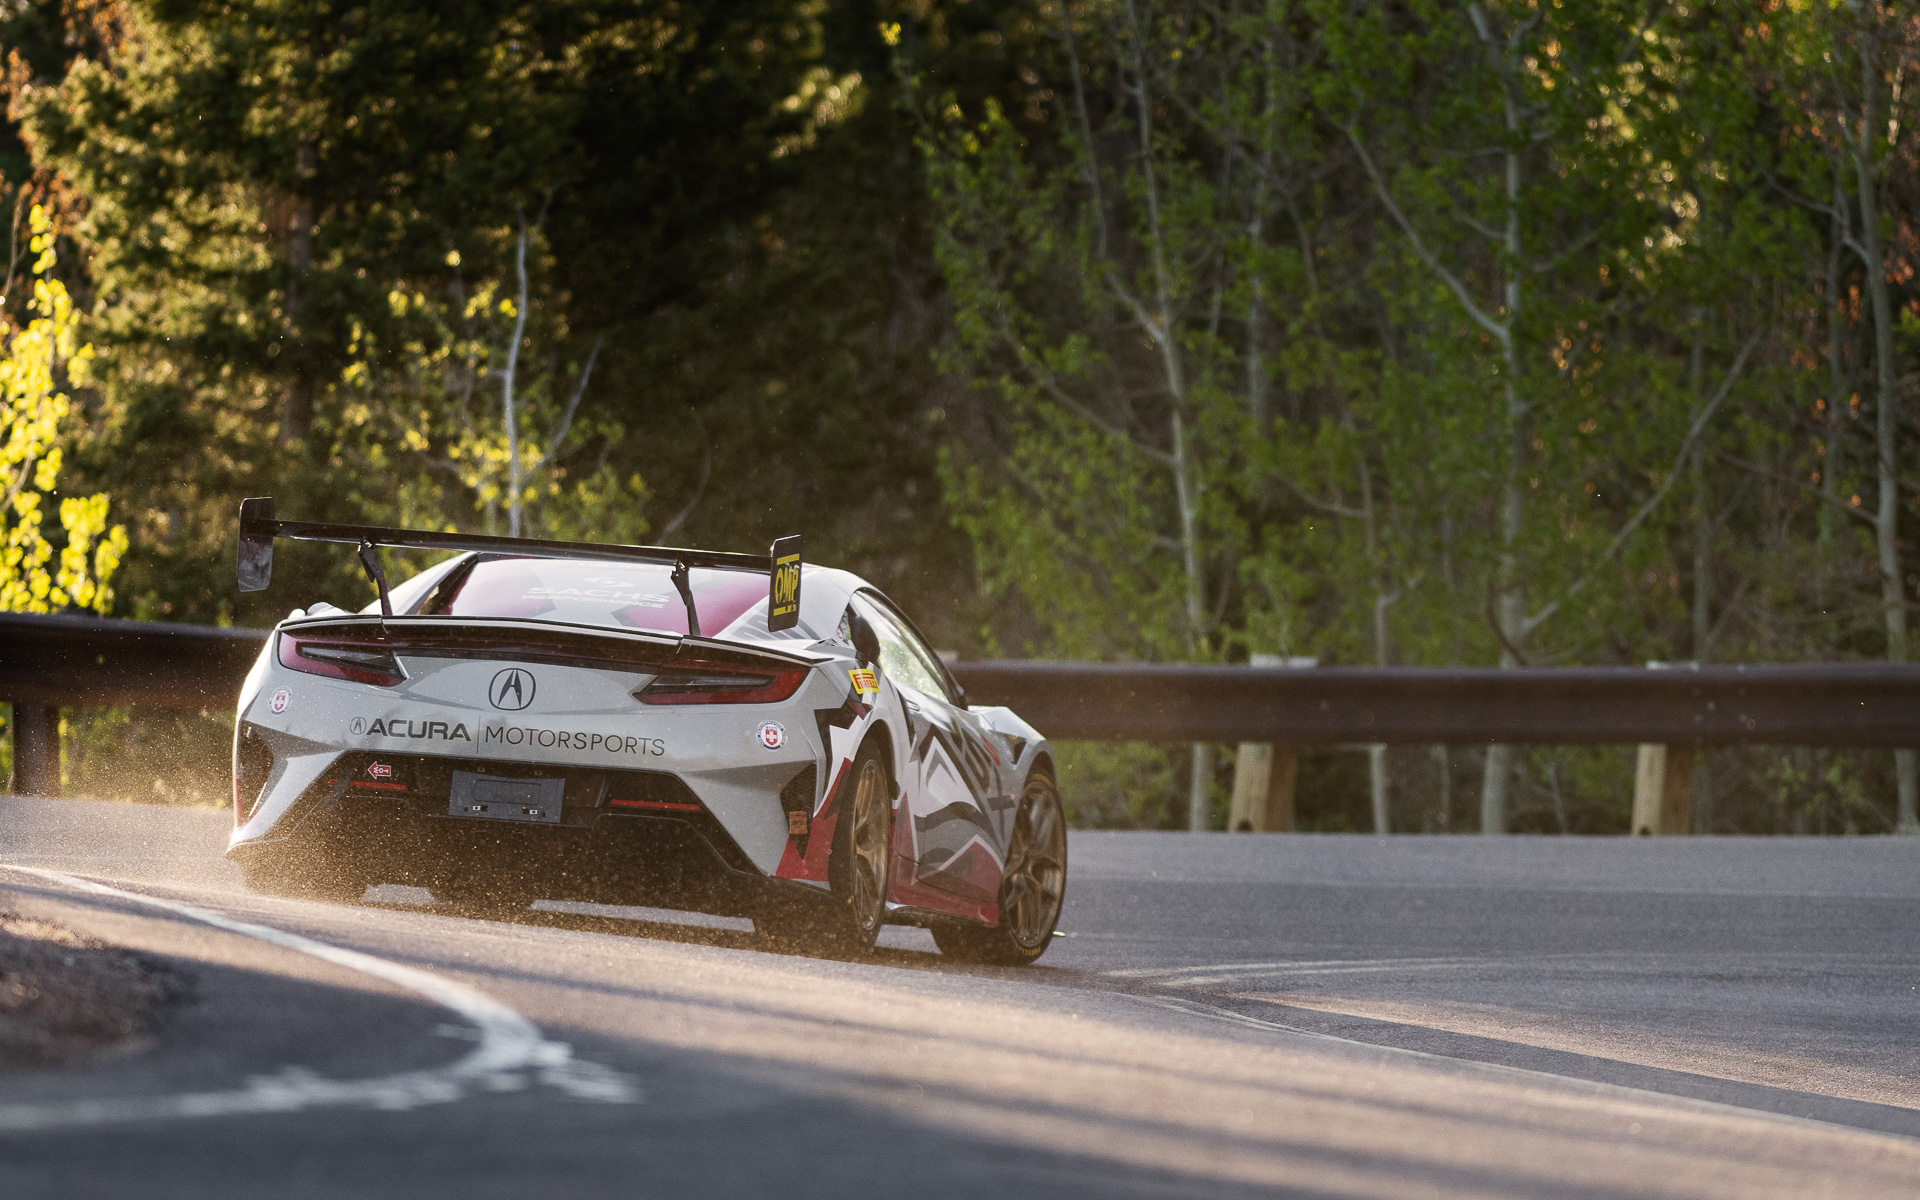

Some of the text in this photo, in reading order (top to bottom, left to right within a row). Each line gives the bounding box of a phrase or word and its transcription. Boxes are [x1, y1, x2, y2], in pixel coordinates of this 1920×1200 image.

[775, 564, 799, 604] OMP
[522, 595, 666, 609] PERFORMANCE
[526, 587, 670, 603] SACHS
[366, 718, 665, 757] ACURA MOTORSPORTS
[373, 766, 389, 774] TOW
